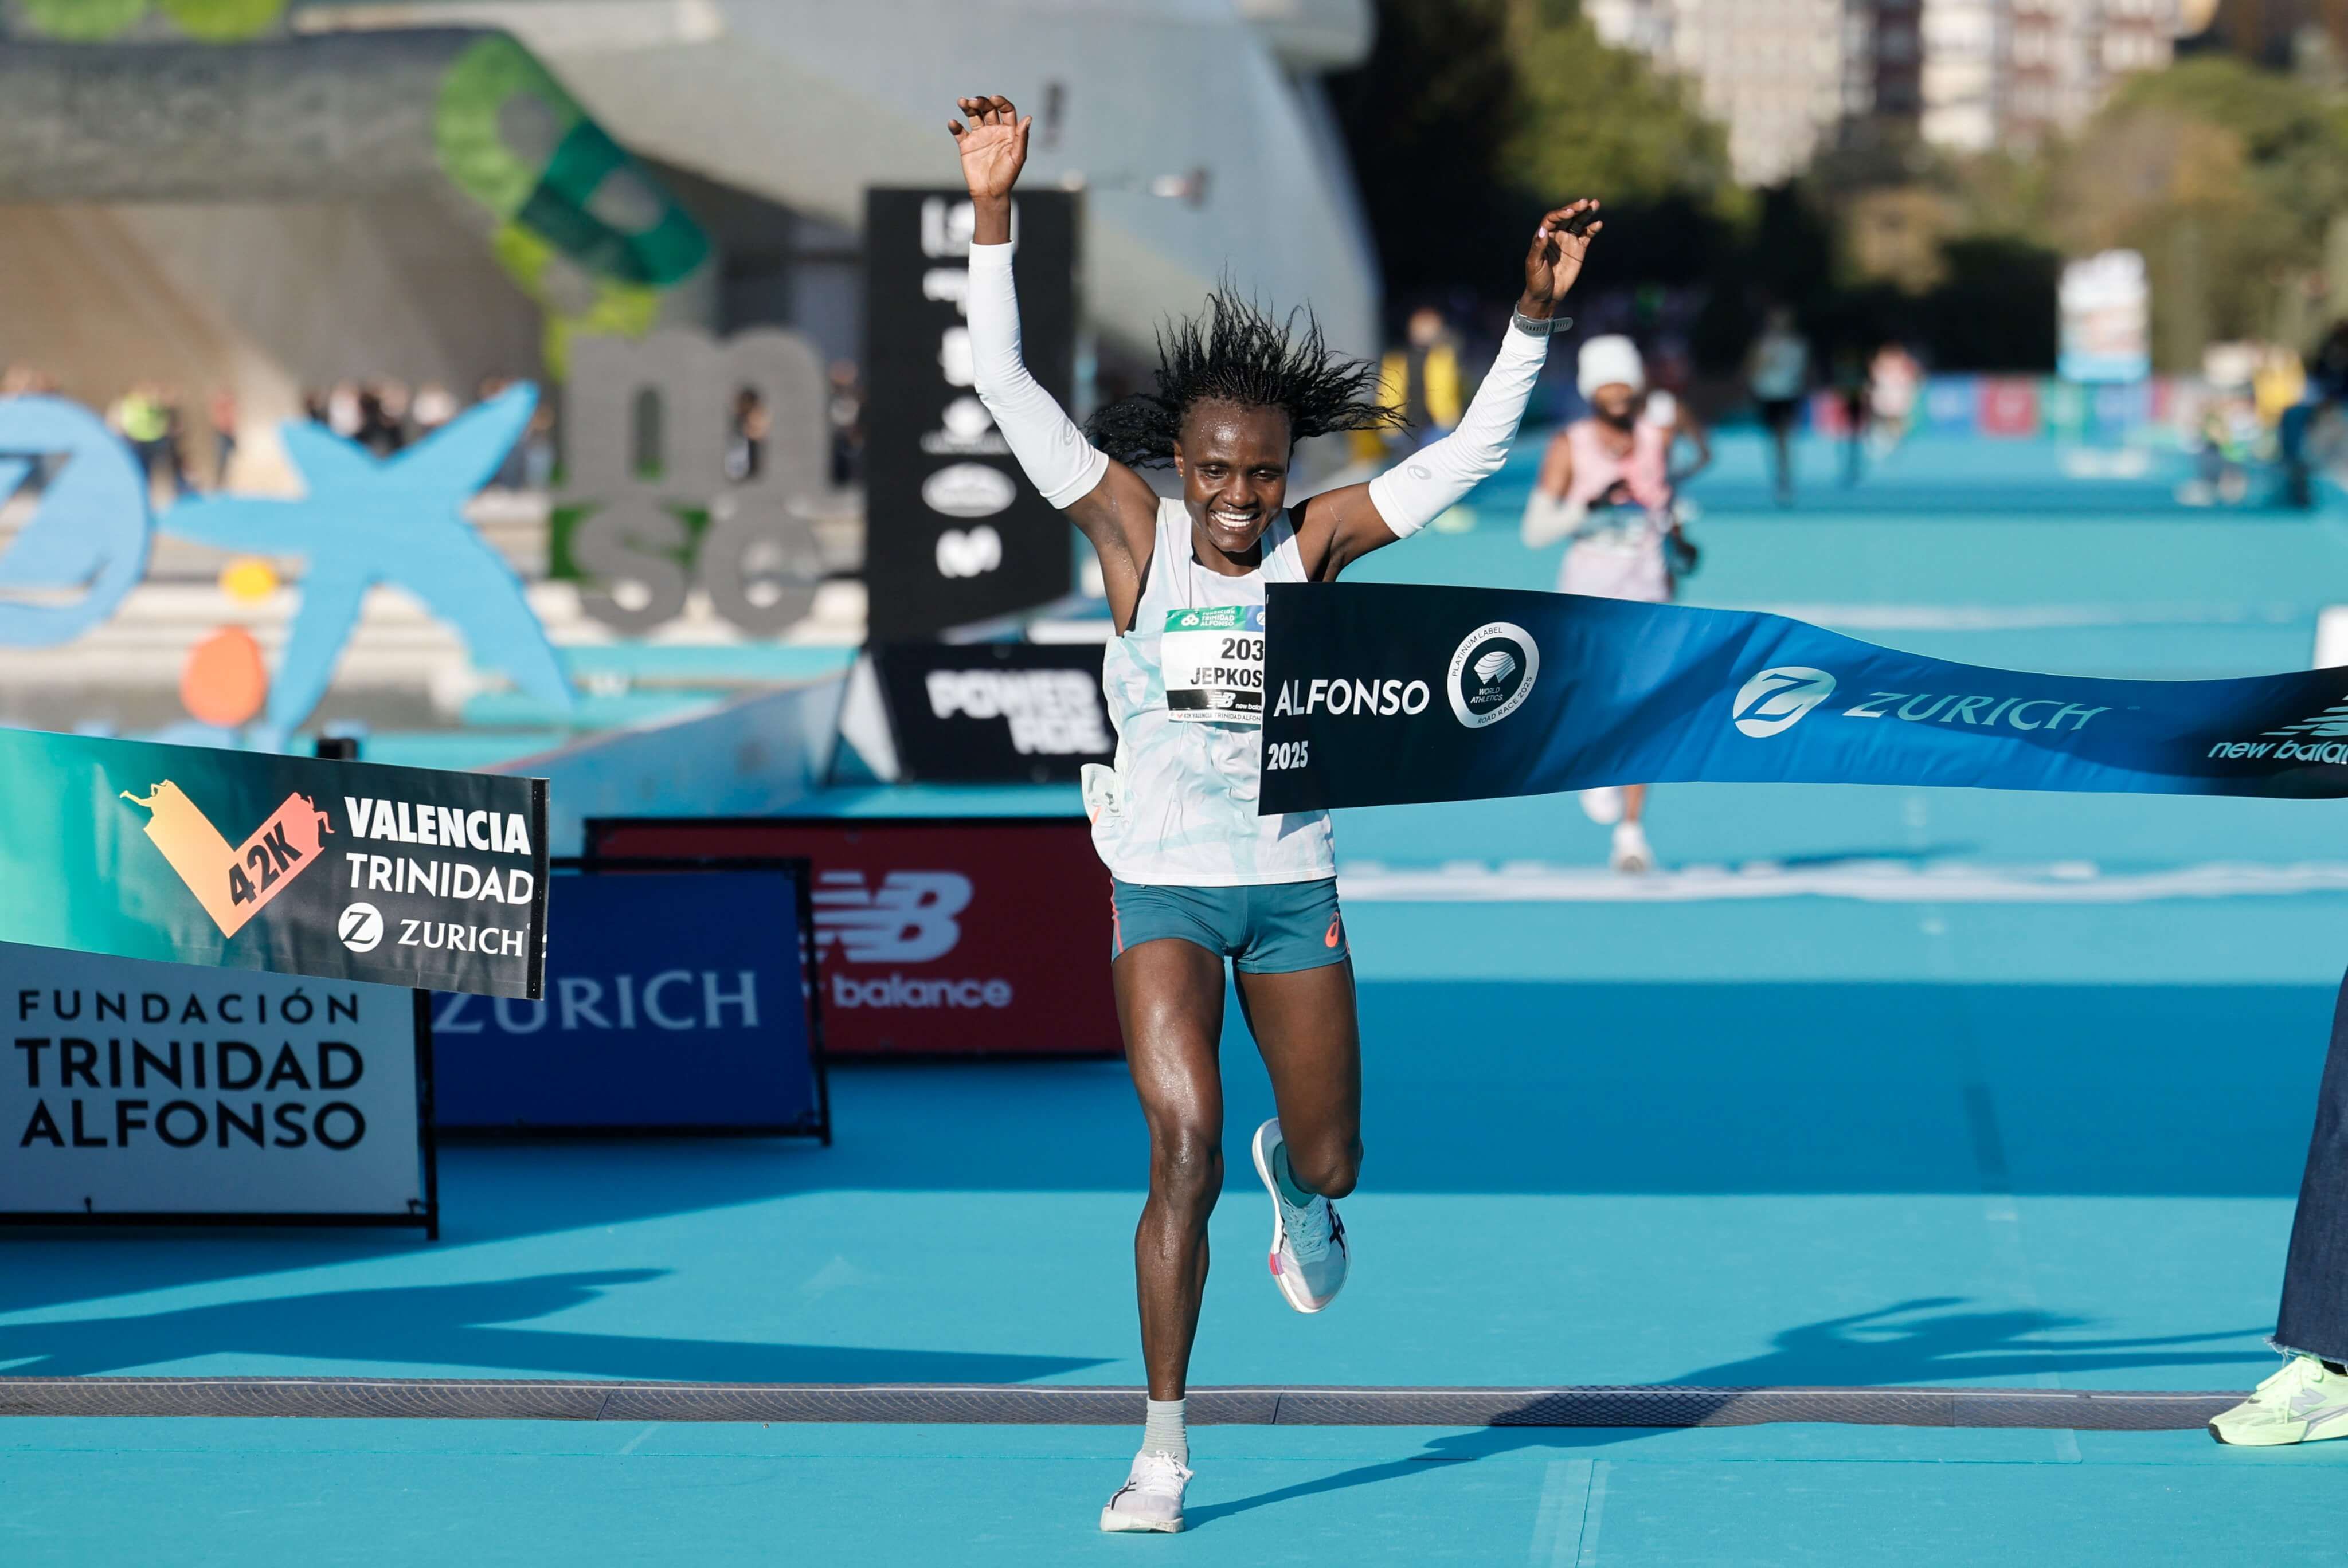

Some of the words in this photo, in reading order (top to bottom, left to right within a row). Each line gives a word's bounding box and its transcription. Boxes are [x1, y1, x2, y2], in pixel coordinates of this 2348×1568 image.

[1452, 636, 1477, 676] PLATINUM
[1478, 626, 1503, 638] LABEL
[924, 669, 1097, 719] POWER
[1273, 678, 1430, 718] ALFONSO
[1470, 694, 1503, 704] ATHLETICS
[1477, 713, 1496, 724] ROAD
[1498, 698, 1519, 716] RACE
[1518, 676, 1532, 699] 2025
[1478, 687, 1500, 696] WORLD
[1841, 691, 2113, 731] ZURICH
[1266, 741, 1308, 771] 2025
[2207, 742, 2276, 759] new
[344, 795, 532, 856] VALENCIA
[229, 820, 303, 907] 42K
[346, 853, 534, 905] TRINIDAD
[397, 919, 524, 957] ZURICH
[19, 987, 359, 1025] FUNDACIÓN
[431, 970, 760, 1034] ZURICH
[832, 972, 1012, 1008] balance
[15, 1038, 364, 1091] TRINIDAD
[19, 1098, 366, 1151] ALFONSO
